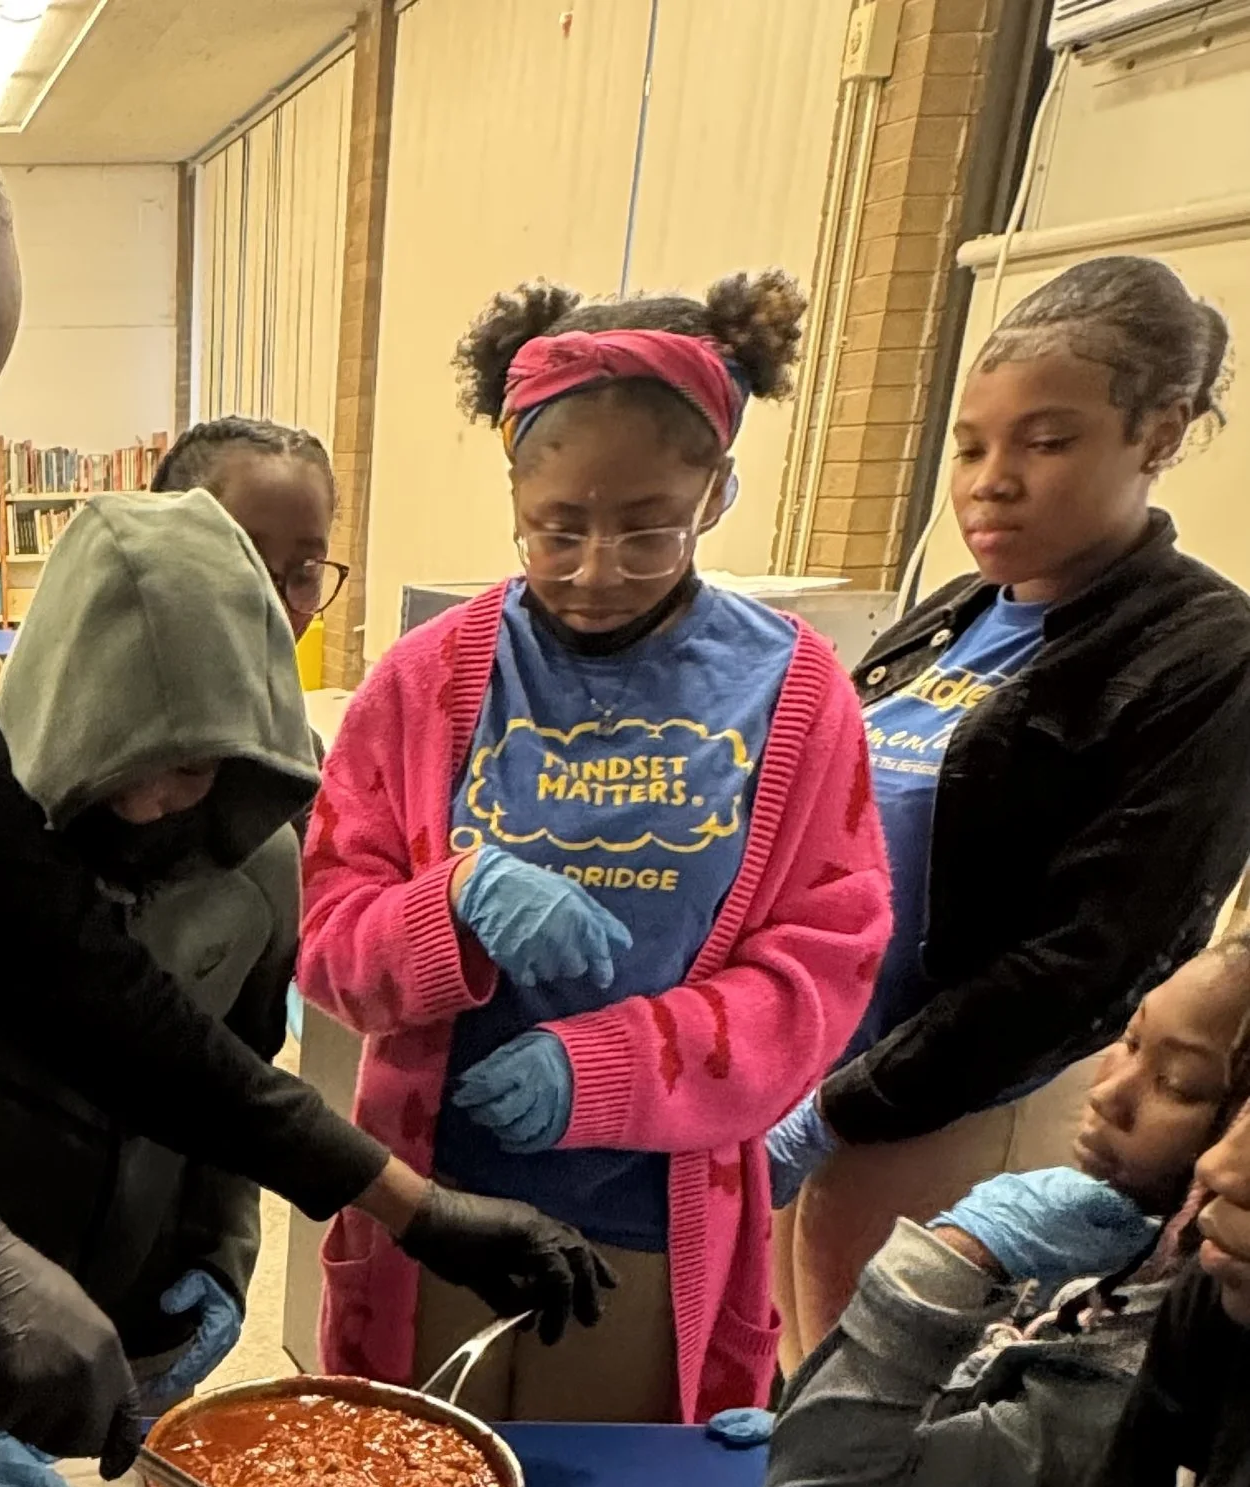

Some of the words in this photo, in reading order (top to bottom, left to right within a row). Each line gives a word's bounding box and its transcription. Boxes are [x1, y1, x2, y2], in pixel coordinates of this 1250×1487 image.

[543, 750, 689, 781] MINDSET
[537, 773, 704, 806] MATTERS.
[549, 865, 680, 891] DRIDGE
